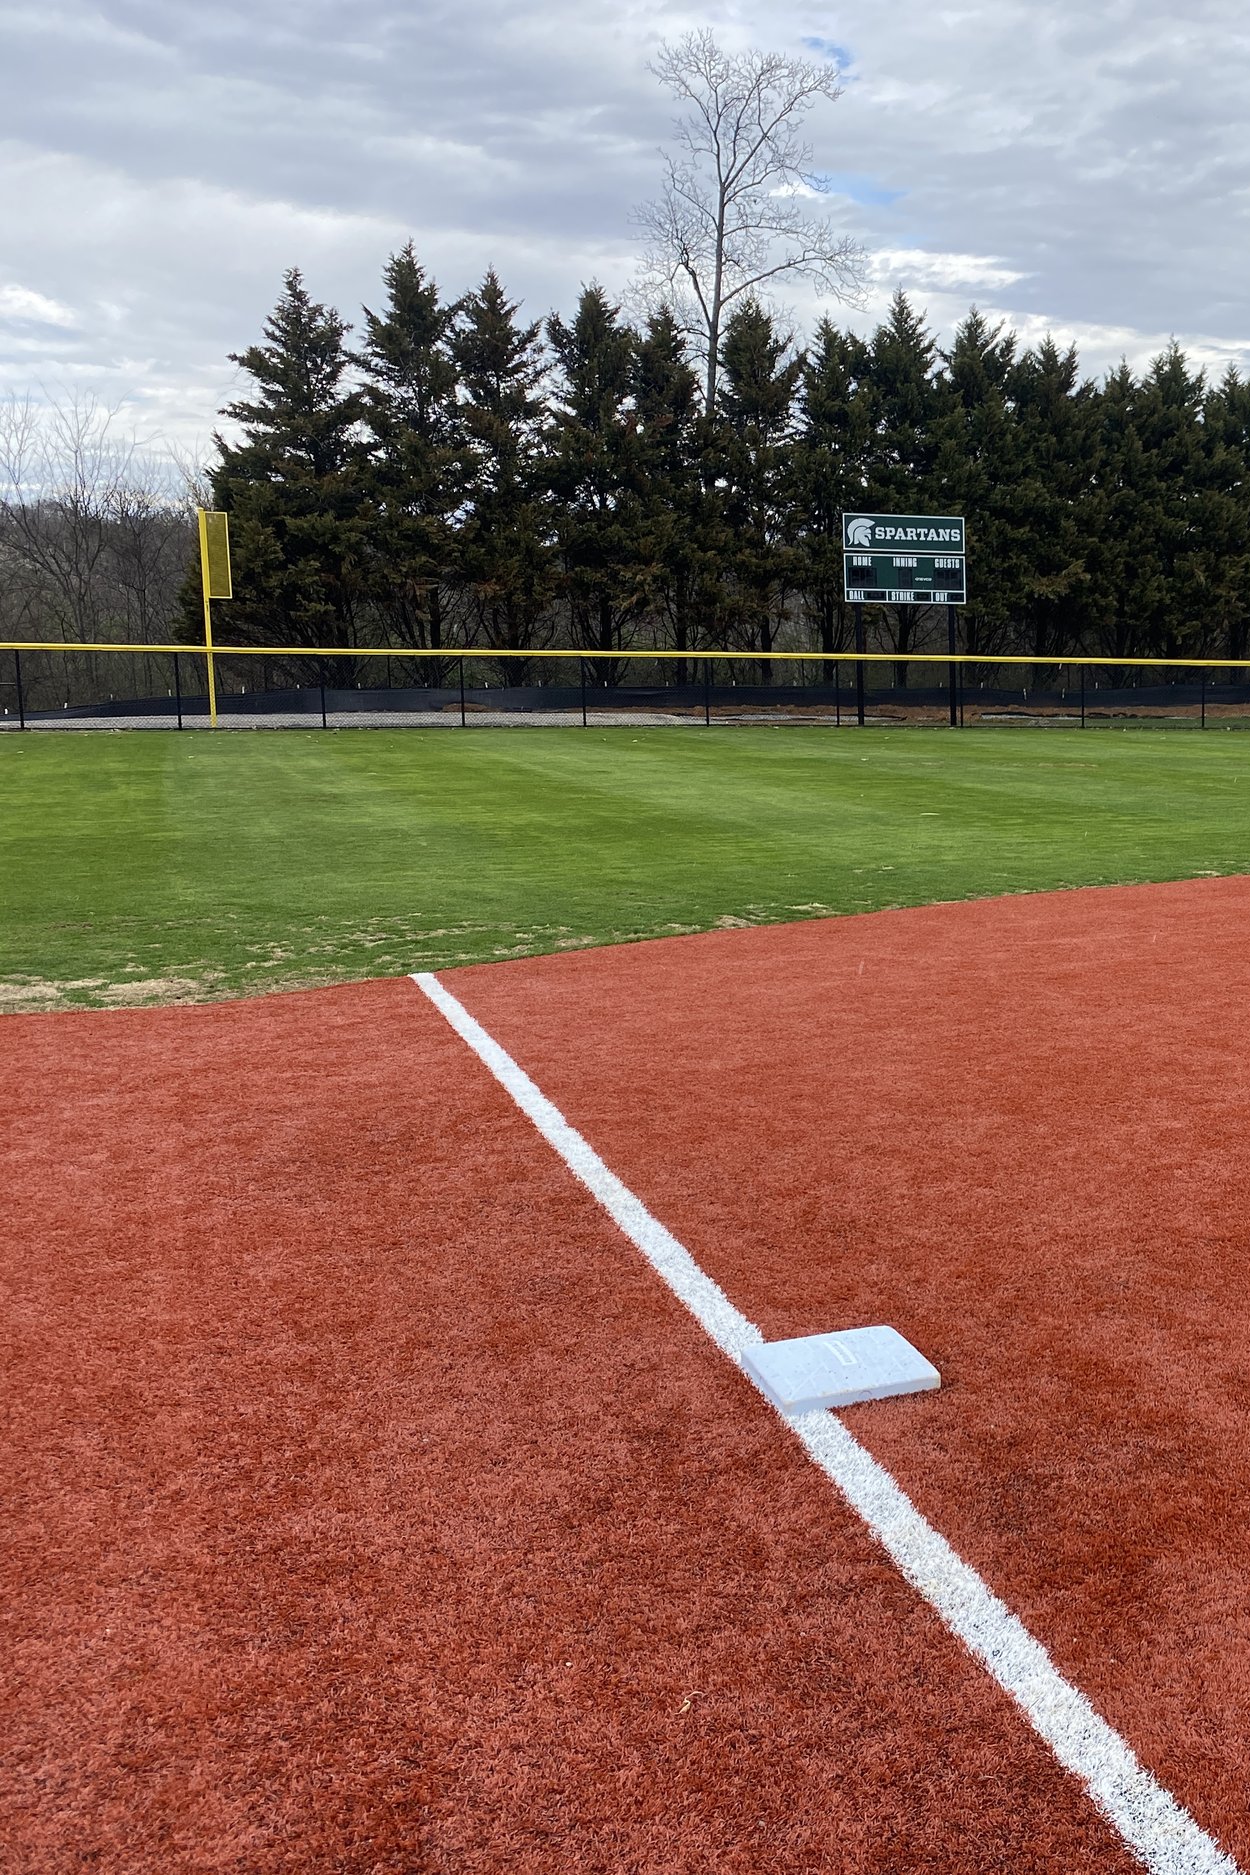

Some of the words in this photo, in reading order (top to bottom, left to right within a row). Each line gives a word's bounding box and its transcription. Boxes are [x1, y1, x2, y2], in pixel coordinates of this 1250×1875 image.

[875, 527, 960, 542] SPARTANS
[852, 556, 872, 566] HOME
[893, 557, 918, 568] INNING
[934, 558, 960, 569] GUESTS
[849, 590, 865, 600] BALL
[891, 591, 915, 601] STRIKE
[935, 592, 948, 602] OUT
